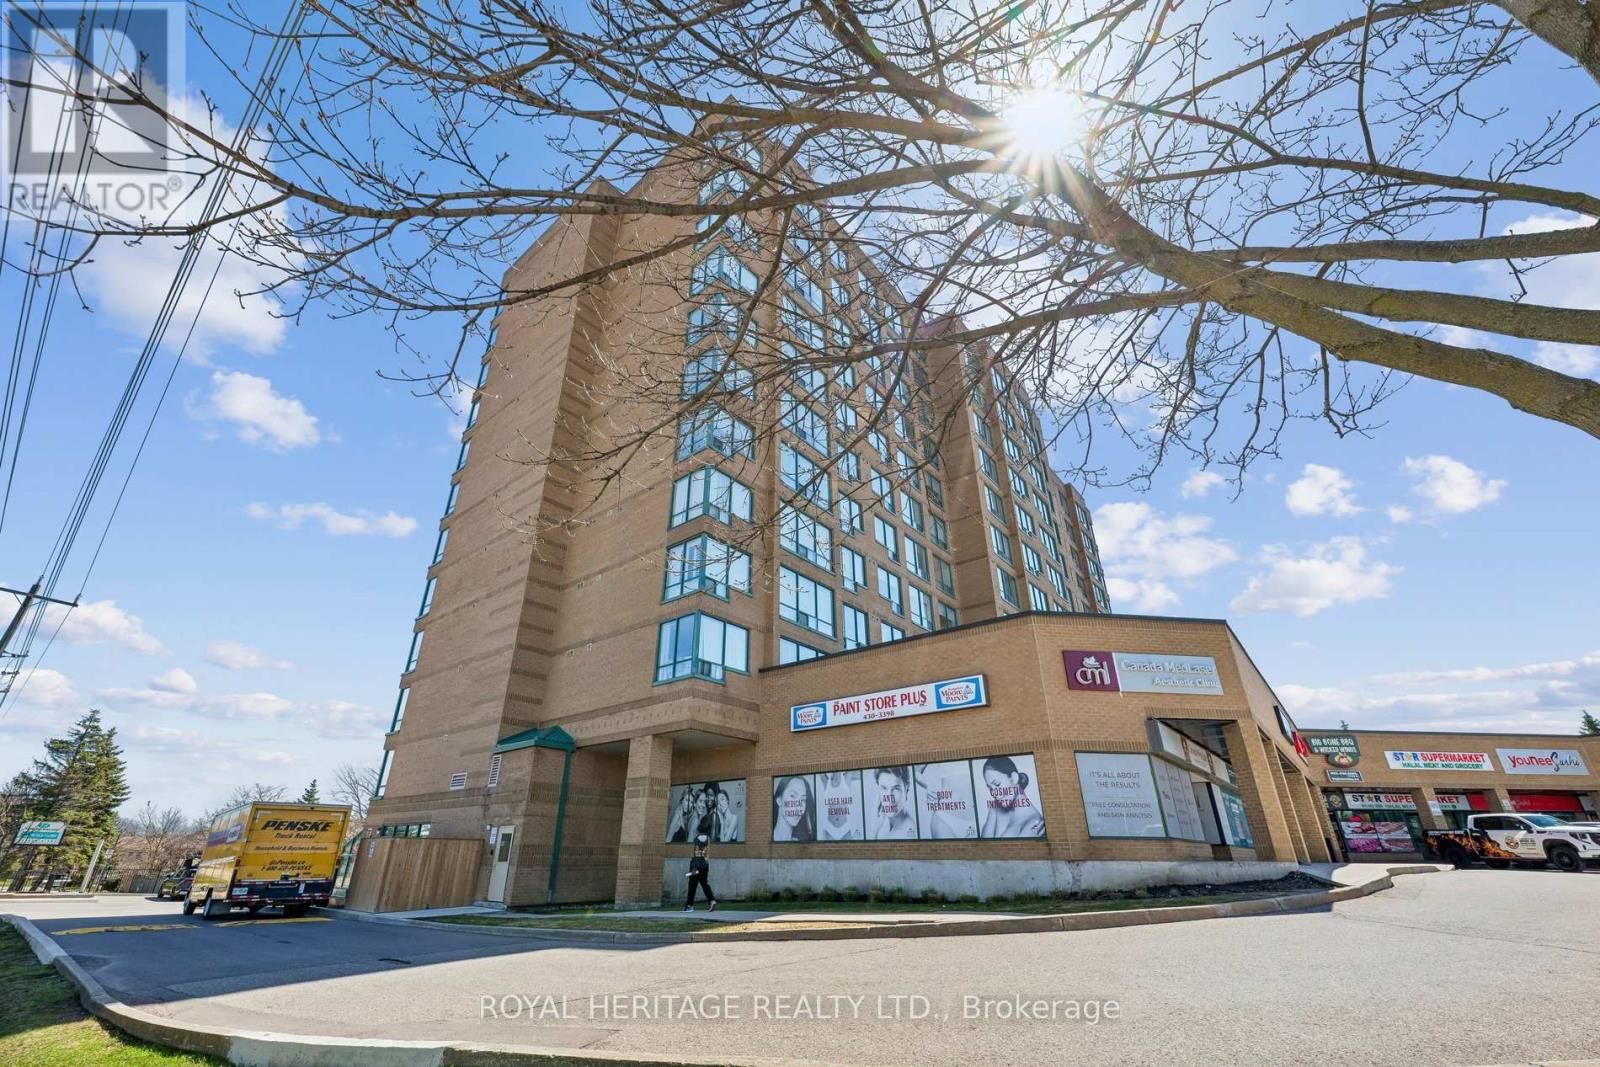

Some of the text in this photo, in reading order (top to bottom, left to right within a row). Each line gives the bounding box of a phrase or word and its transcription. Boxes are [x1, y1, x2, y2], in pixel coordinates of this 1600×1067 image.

[1121, 660, 1163, 672] Canada
[833, 690, 927, 716] PAINT STORE PLUS
[946, 695, 968, 703] PAINTS
[1420, 753, 1486, 763] SUPERMARKET
[1550, 751, 1580, 772] Sushi
[936, 790, 953, 800] BODY
[824, 797, 853, 806] LASER HAIR
[927, 801, 966, 811] TREATMENTS
[828, 807, 851, 816] REMOVAL
[881, 805, 898, 813] AGING
[261, 820, 335, 832] PENSKE
